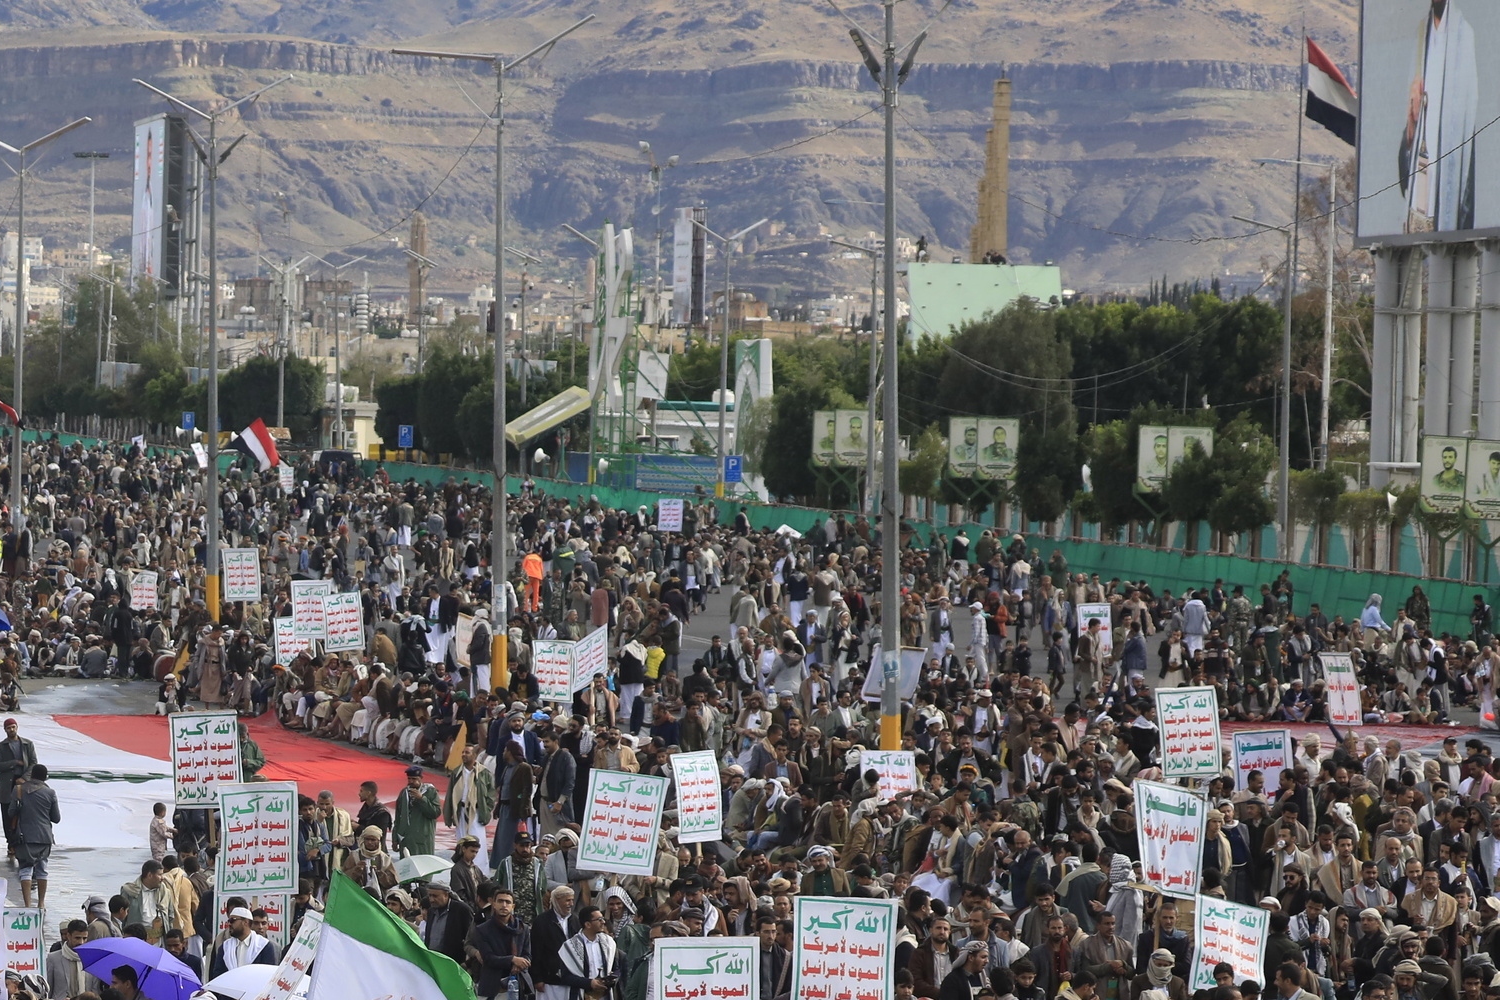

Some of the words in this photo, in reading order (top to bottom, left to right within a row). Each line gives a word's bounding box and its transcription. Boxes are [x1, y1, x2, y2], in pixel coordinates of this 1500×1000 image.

[402, 427, 408, 436] P
[729, 459, 737, 469] P
[1238, 737, 1282, 755] قاطعوا
[227, 794, 264, 820] أكبر
[266, 796, 289, 812] الله
[1145, 786, 1196, 816] قاطعوا
[1170, 826, 1198, 846] البضائع
[1161, 845, 1166, 860] و
[226, 868, 257, 887] للإسلام
[260, 866, 289, 884] النصر
[803, 905, 854, 934] أكبر
[855, 910, 886, 933] الله
[804, 935, 846, 955] لأمريكا
[850, 943, 884, 958] الموت
[802, 960, 845, 980] لإسرائيل
[849, 966, 883, 981] الموت
